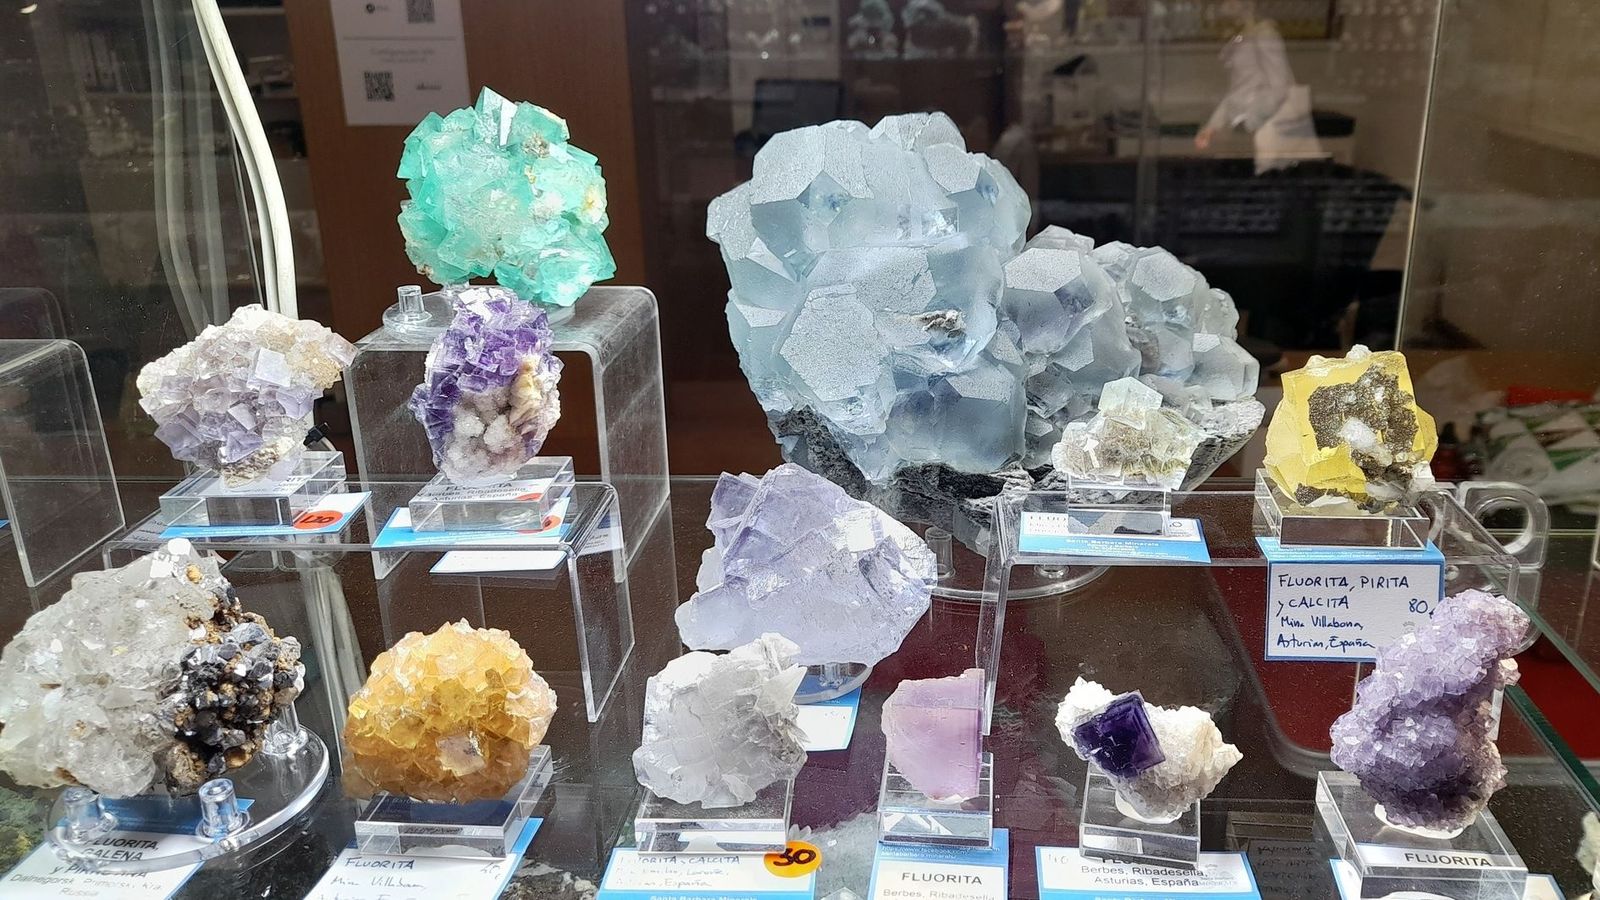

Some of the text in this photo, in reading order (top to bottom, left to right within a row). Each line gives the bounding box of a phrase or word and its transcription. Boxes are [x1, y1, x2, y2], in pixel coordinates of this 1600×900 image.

[1278, 573, 1409, 592] FLUORITA, PIRITA
[1276, 595, 1349, 617] y CALCITA
[1281, 616, 1305, 628] Mina
[1329, 636, 1376, 653] España
[345, 857, 415, 869] FLUORITA
[688, 855, 740, 864] CALCITA
[773, 847, 816, 867] 30
[1405, 852, 1492, 866] FLUORITA
[1081, 866, 1208, 877] Berbes, Ribadesella,
[902, 872, 982, 885] FLUORITA
[1094, 876, 1149, 886] Asturias,
[1152, 877, 1200, 888] España
[883, 888, 925, 898] Berbes,
